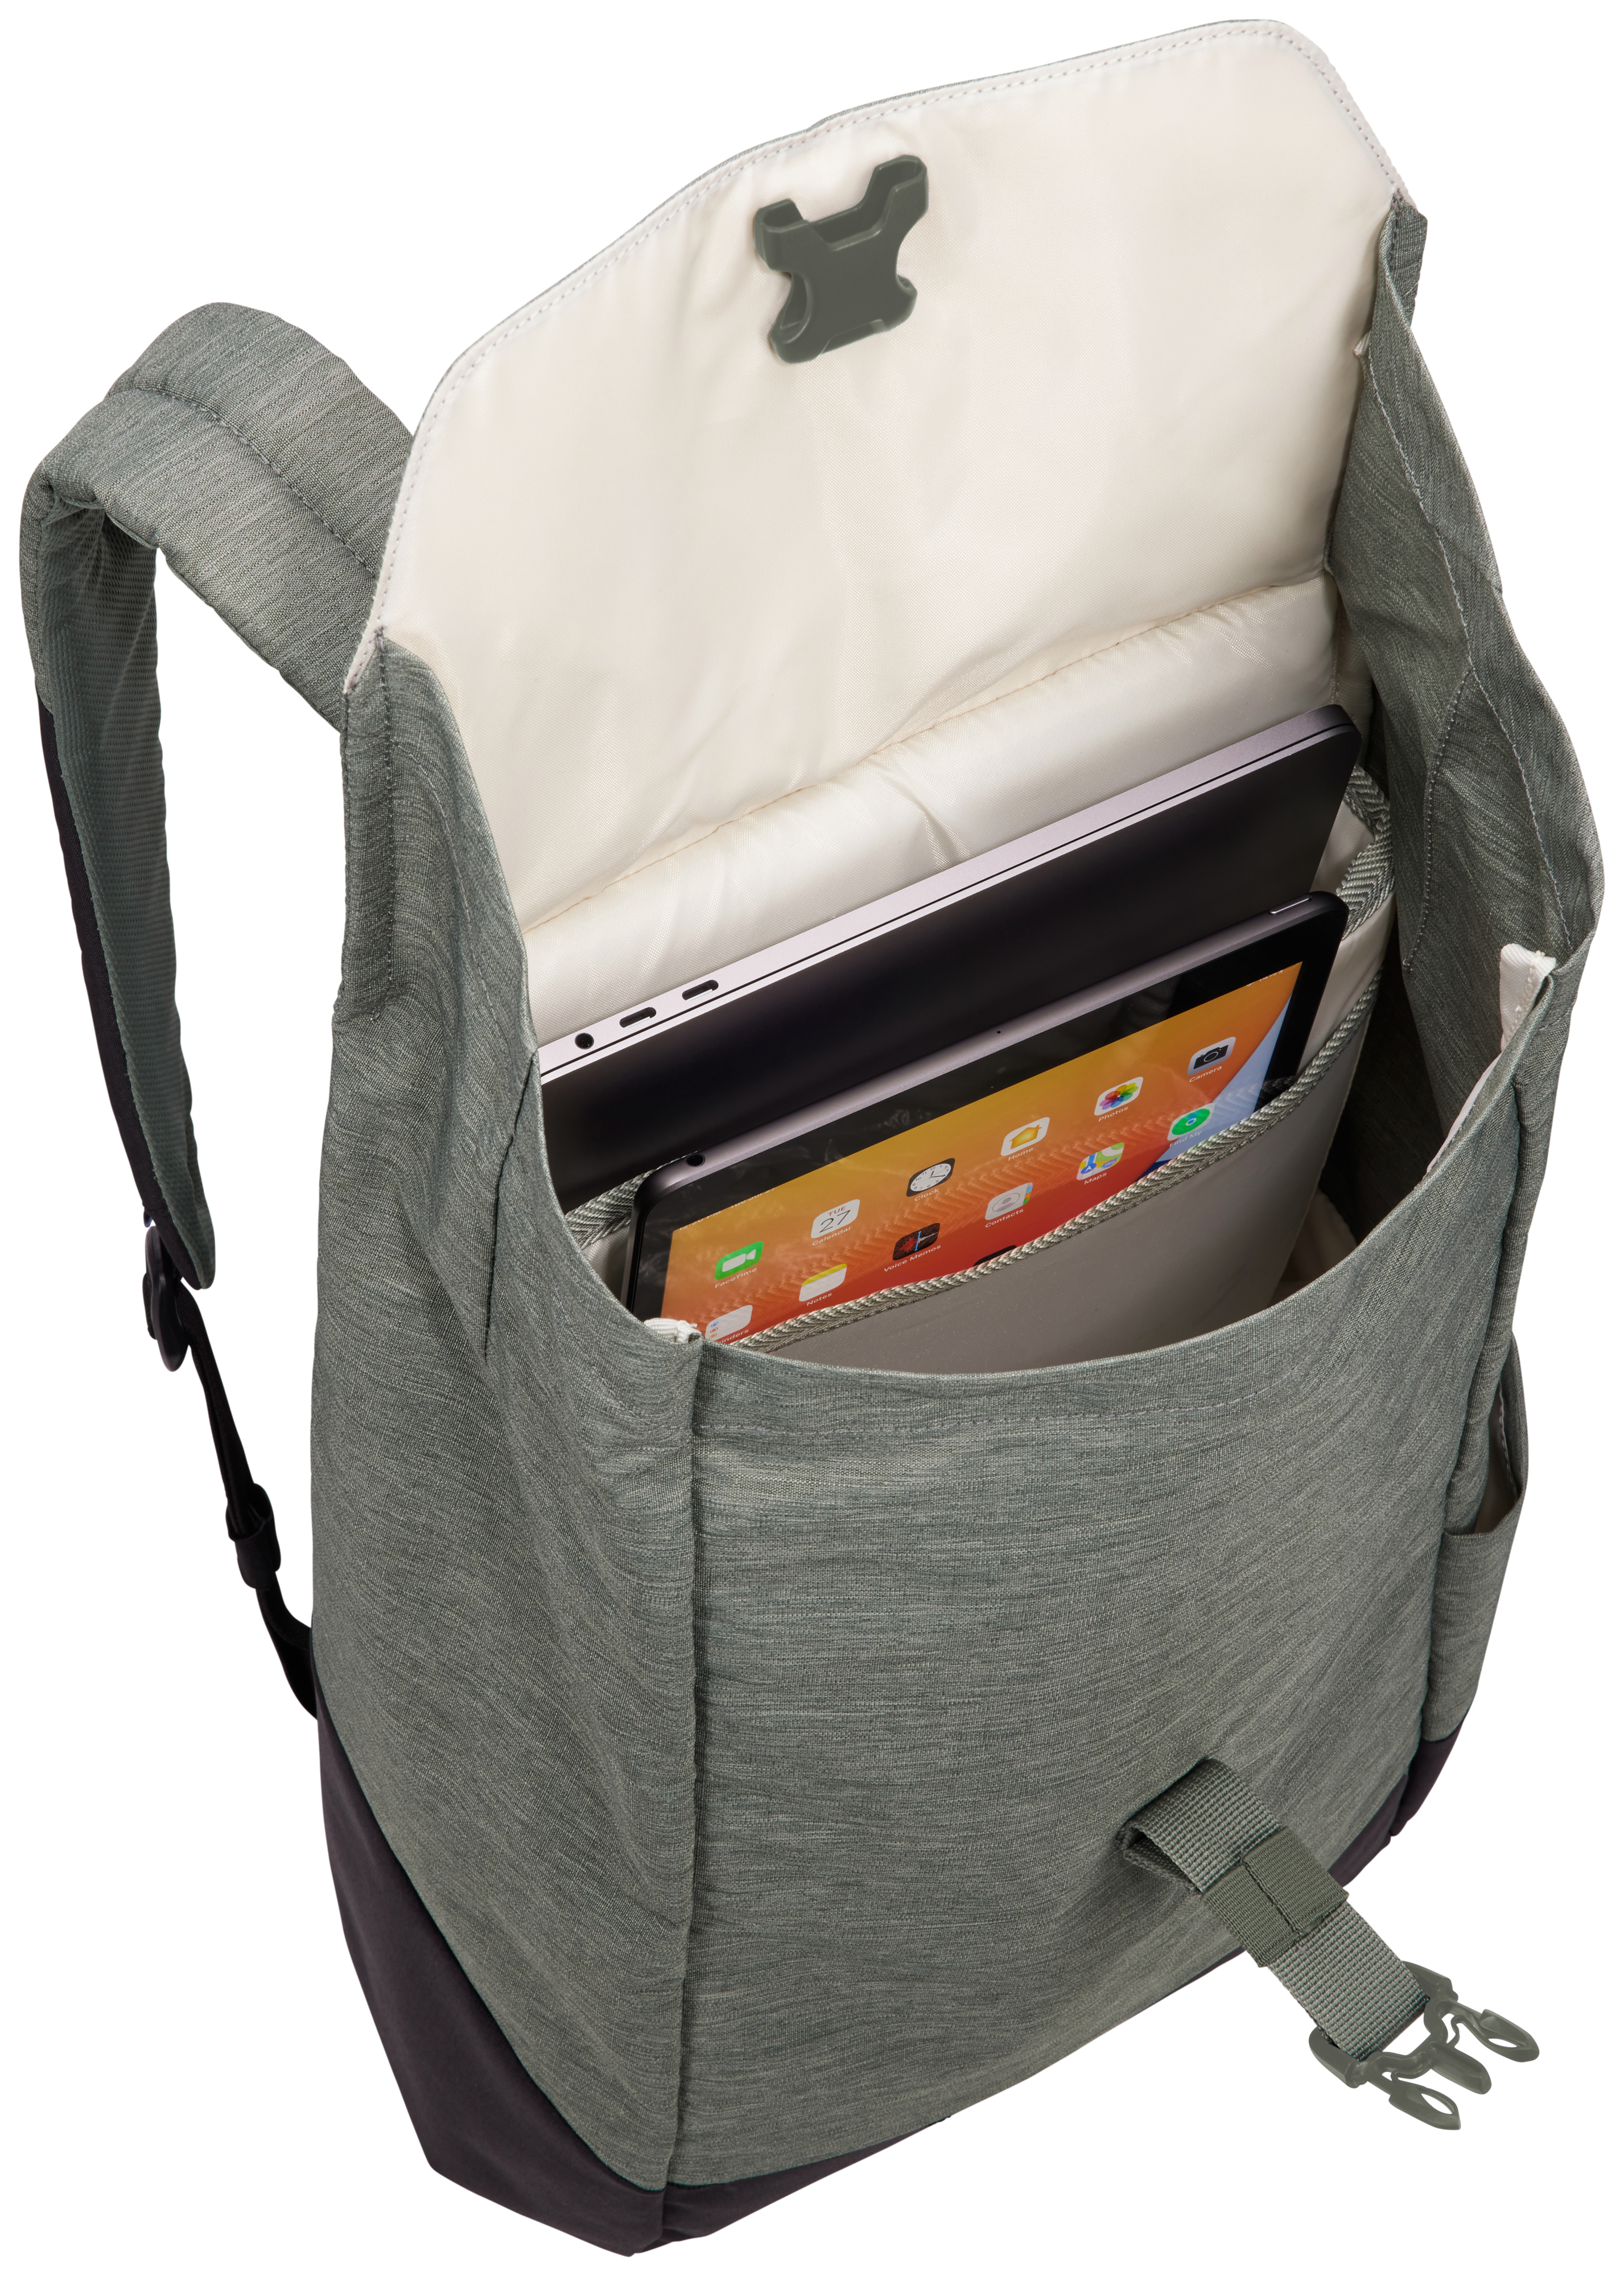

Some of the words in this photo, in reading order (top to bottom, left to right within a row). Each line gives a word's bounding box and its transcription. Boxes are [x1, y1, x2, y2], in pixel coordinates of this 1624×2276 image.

[1189, 1066, 1222, 1082] Camera
[1098, 1106, 1128, 1122] Photos
[1169, 1136, 1188, 1148] Find
[1008, 1148, 1034, 1161] Home
[1084, 1172, 1107, 1185] Maps
[914, 1188, 939, 1201] Clock
[828, 1205, 846, 1217] TUE
[985, 1208, 1024, 1228] Contacts
[819, 1209, 851, 1234] 27
[812, 1226, 852, 1246] Calendar
[884, 1260, 908, 1272] Voice
[909, 1244, 941, 1261] Memos
[715, 1267, 757, 1289] FaceTime
[806, 1292, 832, 1306] Notes
